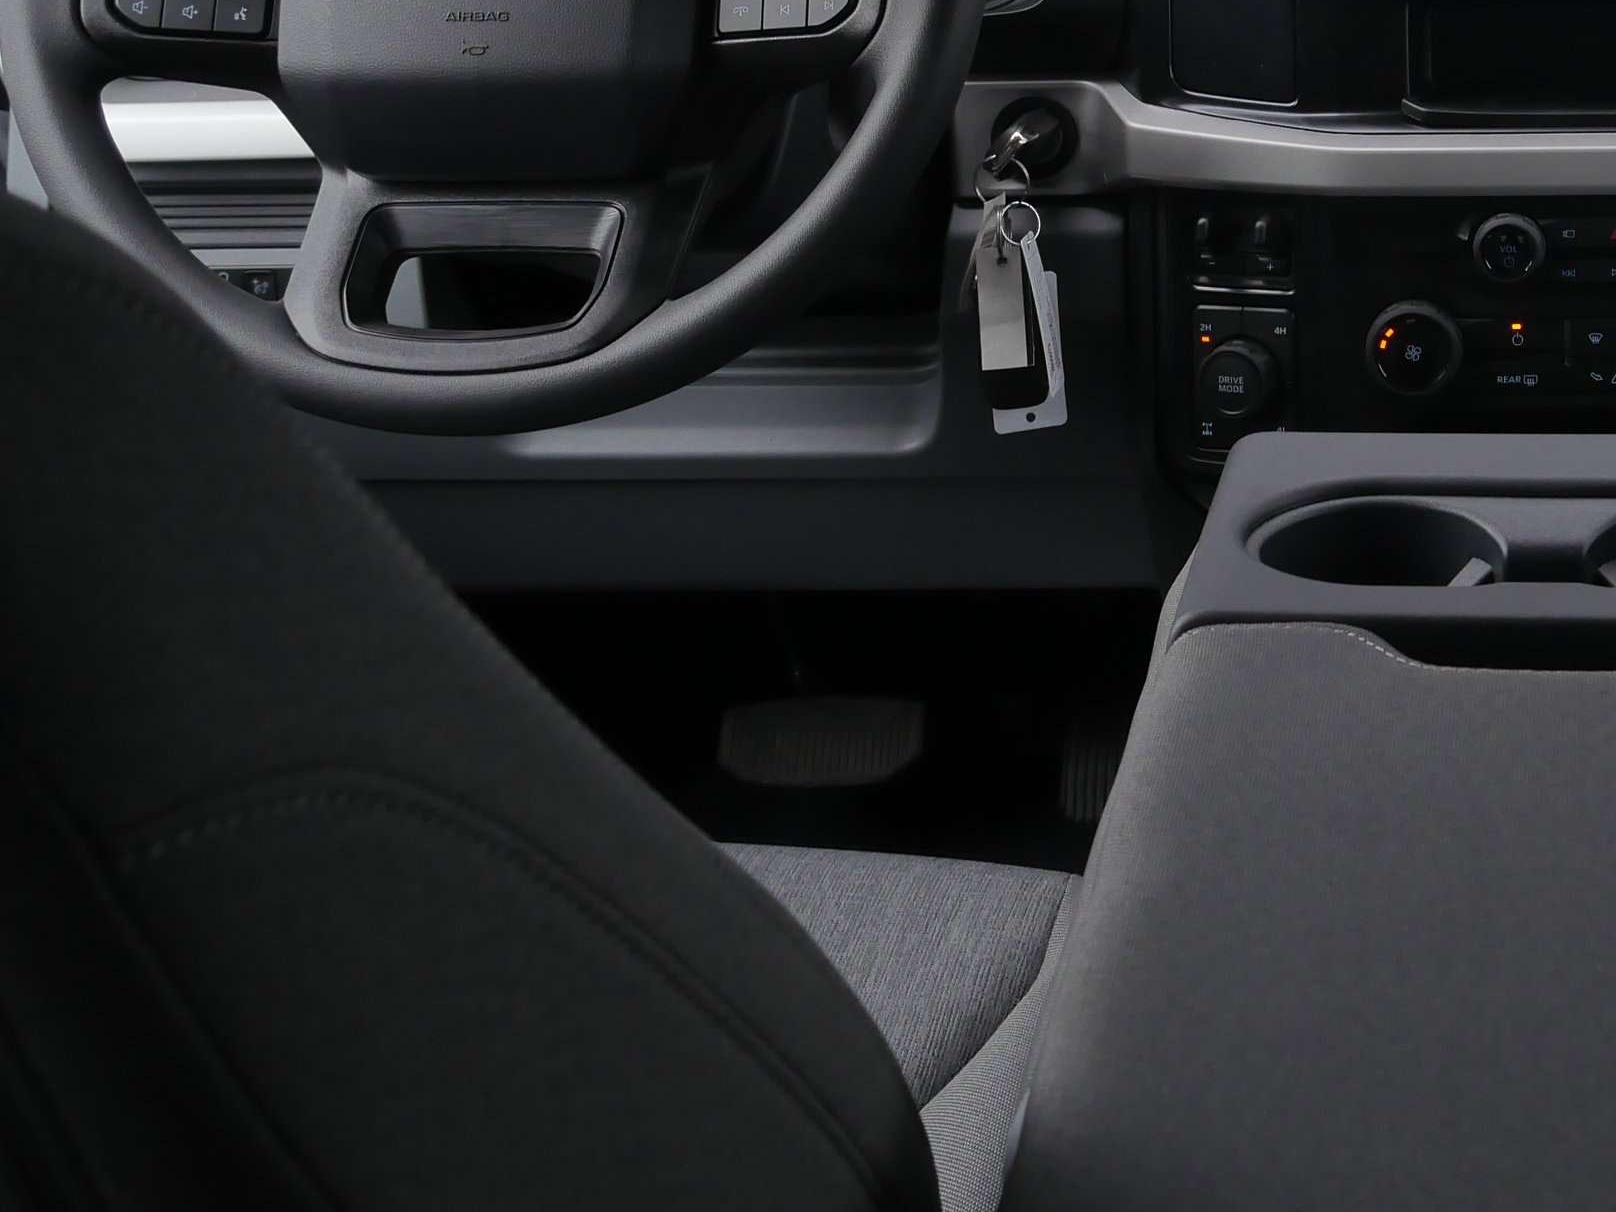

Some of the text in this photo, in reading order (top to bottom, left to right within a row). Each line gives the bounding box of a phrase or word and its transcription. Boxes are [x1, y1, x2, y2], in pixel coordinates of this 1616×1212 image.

[445, 12, 510, 22] AIRBAG
[1500, 245, 1518, 254] VOL
[1274, 327, 1287, 335] 4H
[1218, 376, 1244, 385] DRIVE
[1497, 376, 1521, 384] REAR
[1218, 384, 1244, 393] MODE
